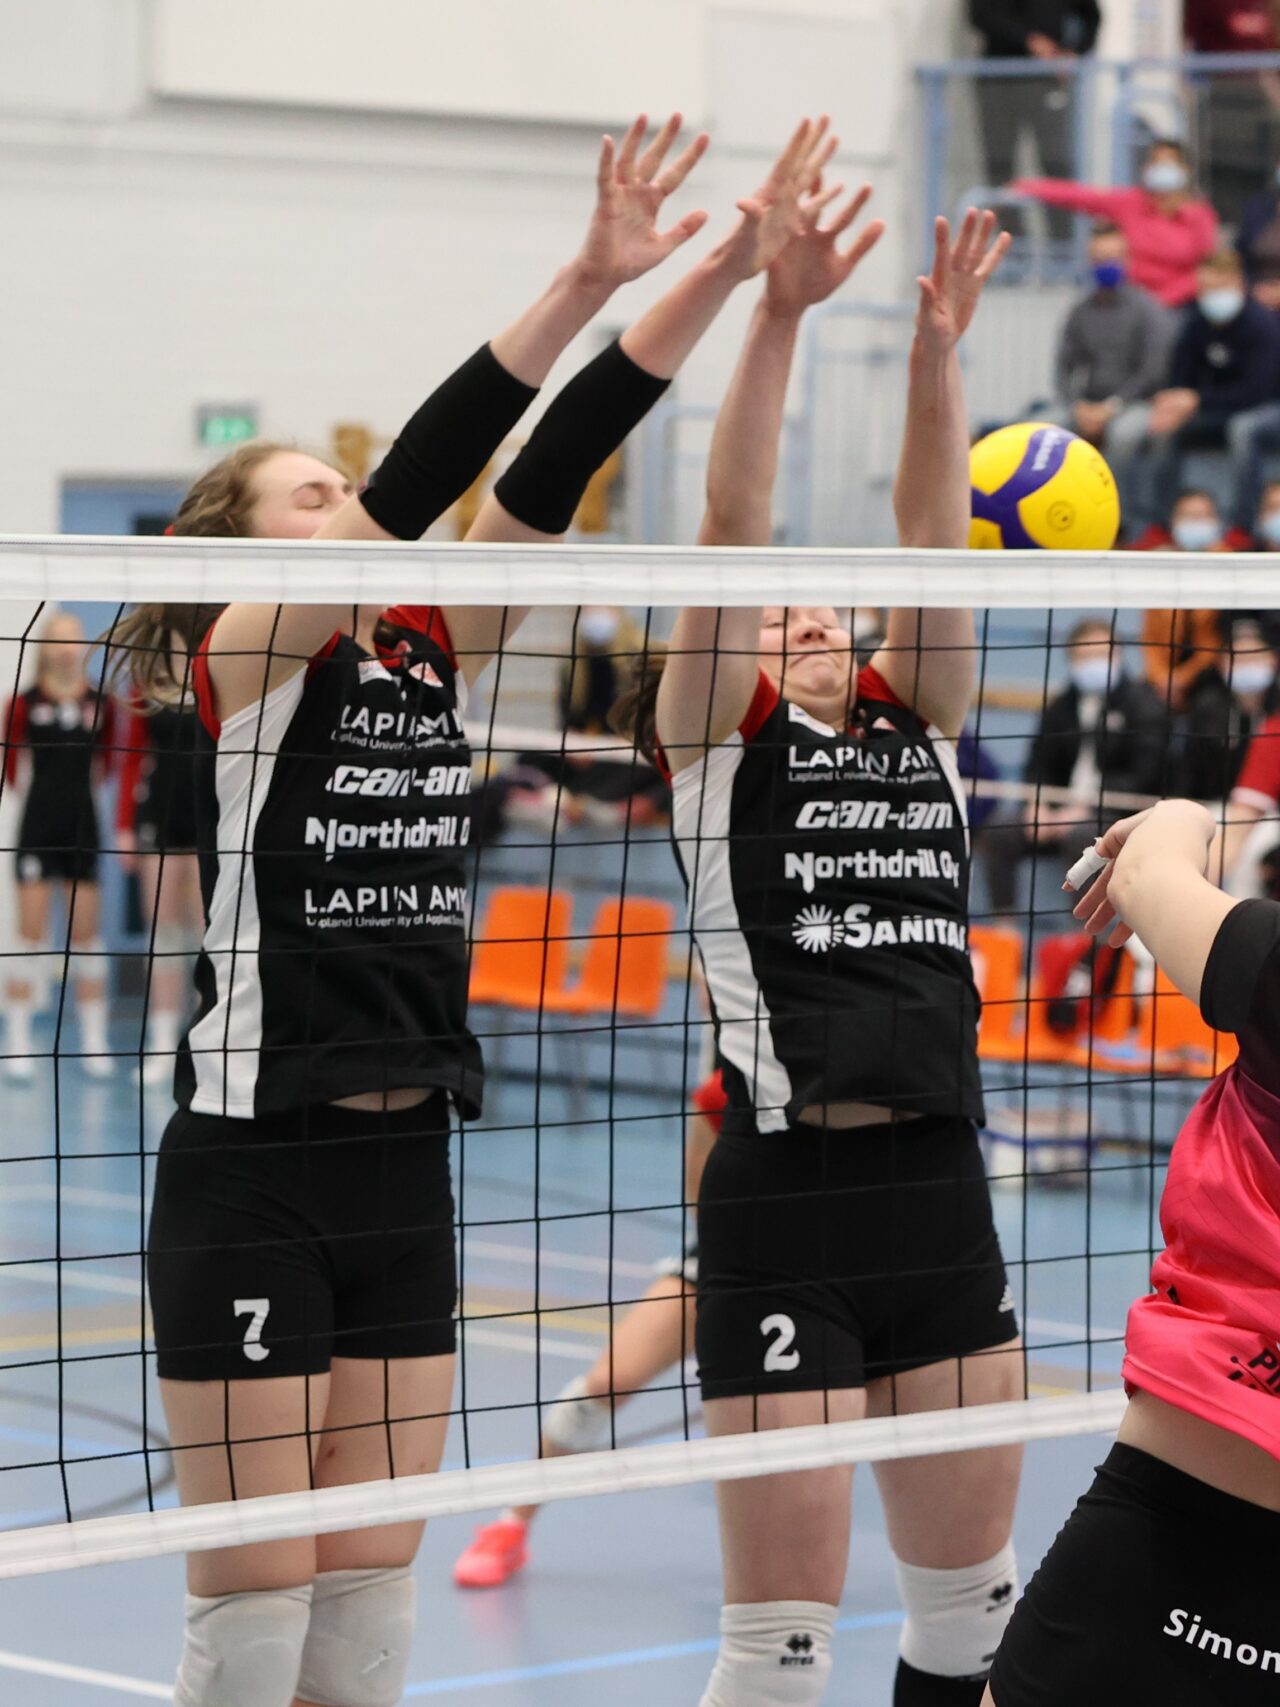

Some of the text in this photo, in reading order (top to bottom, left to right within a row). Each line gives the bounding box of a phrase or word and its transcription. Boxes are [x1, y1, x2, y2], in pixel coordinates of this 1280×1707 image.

[788, 745, 890, 776] LAPIN
[305, 816, 458, 862] Northdrill
[784, 849, 960, 893] Northdrill Oy
[304, 885, 419, 914] LAPIN
[233, 1298, 270, 1361] 7
[760, 1313, 800, 1373] 2
